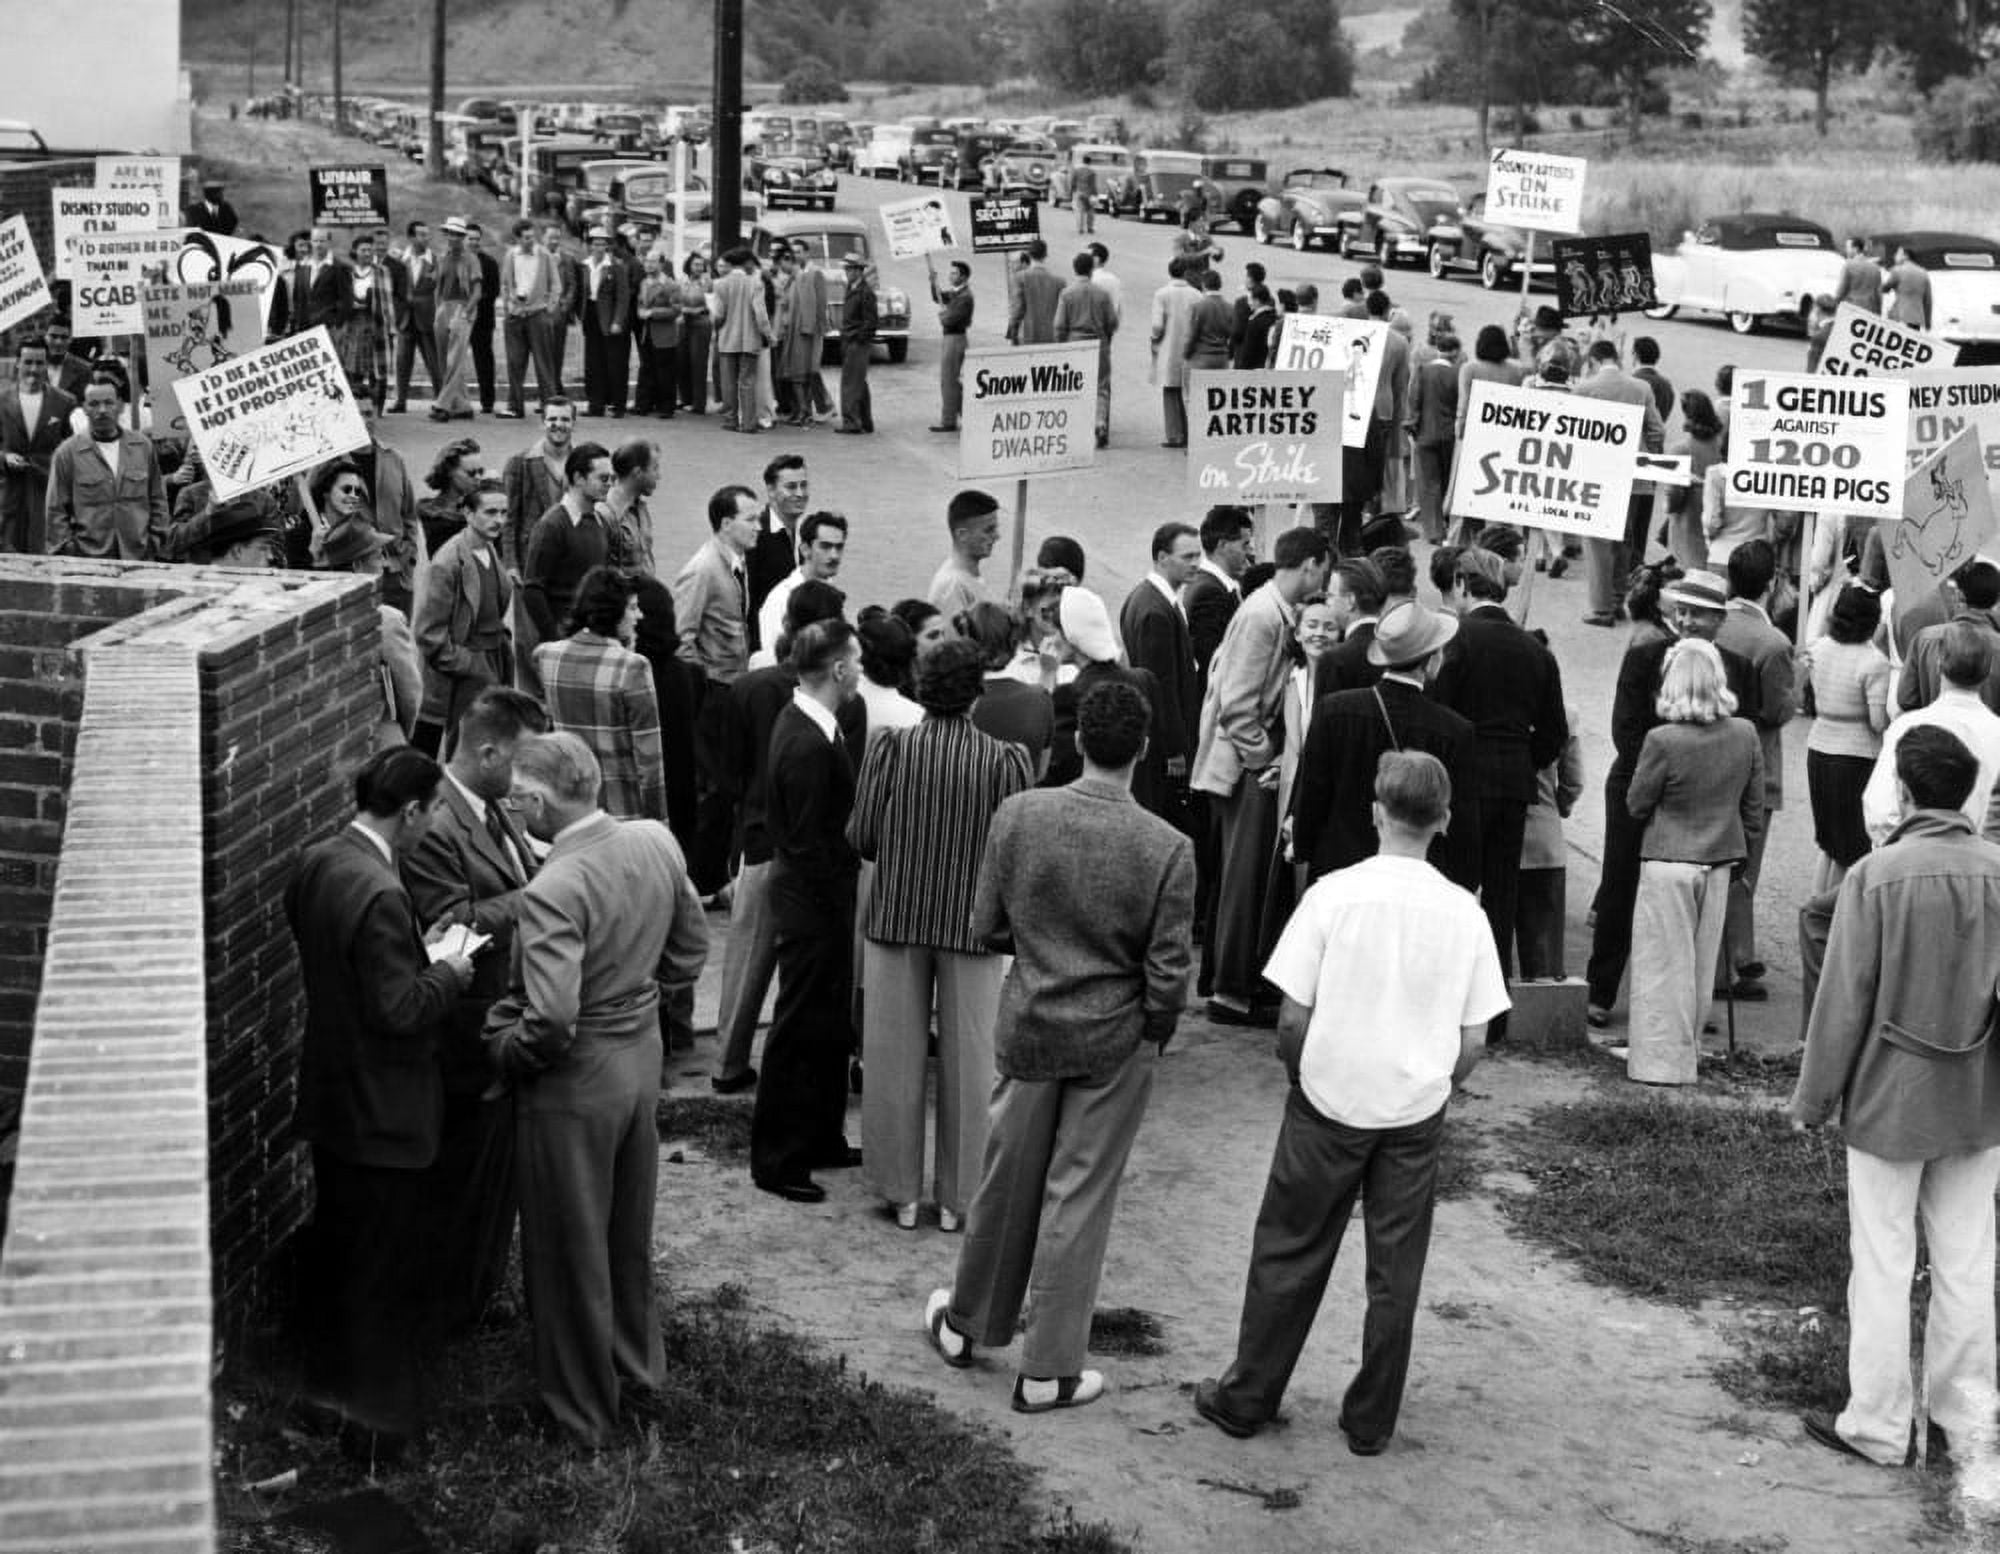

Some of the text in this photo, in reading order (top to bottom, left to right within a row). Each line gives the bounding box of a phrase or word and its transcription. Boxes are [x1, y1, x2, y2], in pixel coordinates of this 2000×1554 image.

[1496, 160, 1533, 174] DISNEY
[1520, 177, 1547, 193] ON
[61, 202, 103, 216] DISNEY
[105, 202, 150, 217] STUDIO
[1495, 186, 1567, 213] STRIKE
[976, 207, 1030, 222] SECURITY
[80, 285, 137, 308] SCAB
[148, 306, 170, 320] ME
[1850, 319, 1933, 363] GILDED
[225, 364, 246, 383] BE
[247, 360, 259, 375] A
[260, 337, 320, 369] SUCKER
[194, 397, 212, 414] IF
[215, 392, 224, 407] I
[281, 354, 321, 380] HIRE
[322, 351, 333, 364] A
[975, 362, 1084, 399] Snow White
[1207, 386, 1316, 411] DISNEY
[1741, 379, 1886, 418] 1 GENIUS
[1908, 386, 1943, 410] NEY
[991, 409, 1068, 433] AND 700
[1207, 412, 1318, 437] ARTISTS
[1481, 402, 1628, 445] DISNEY STUDIO
[1772, 418, 1840, 435] AGAINST
[1916, 415, 1965, 443] ON
[991, 434, 1068, 460] DWARFS
[1518, 437, 1574, 470] ON
[1747, 438, 1861, 469] 1200
[1200, 442, 1320, 489] on Strike
[1473, 452, 1601, 508] STRIKE
[1733, 469, 1890, 504] GUINEA PIGS
